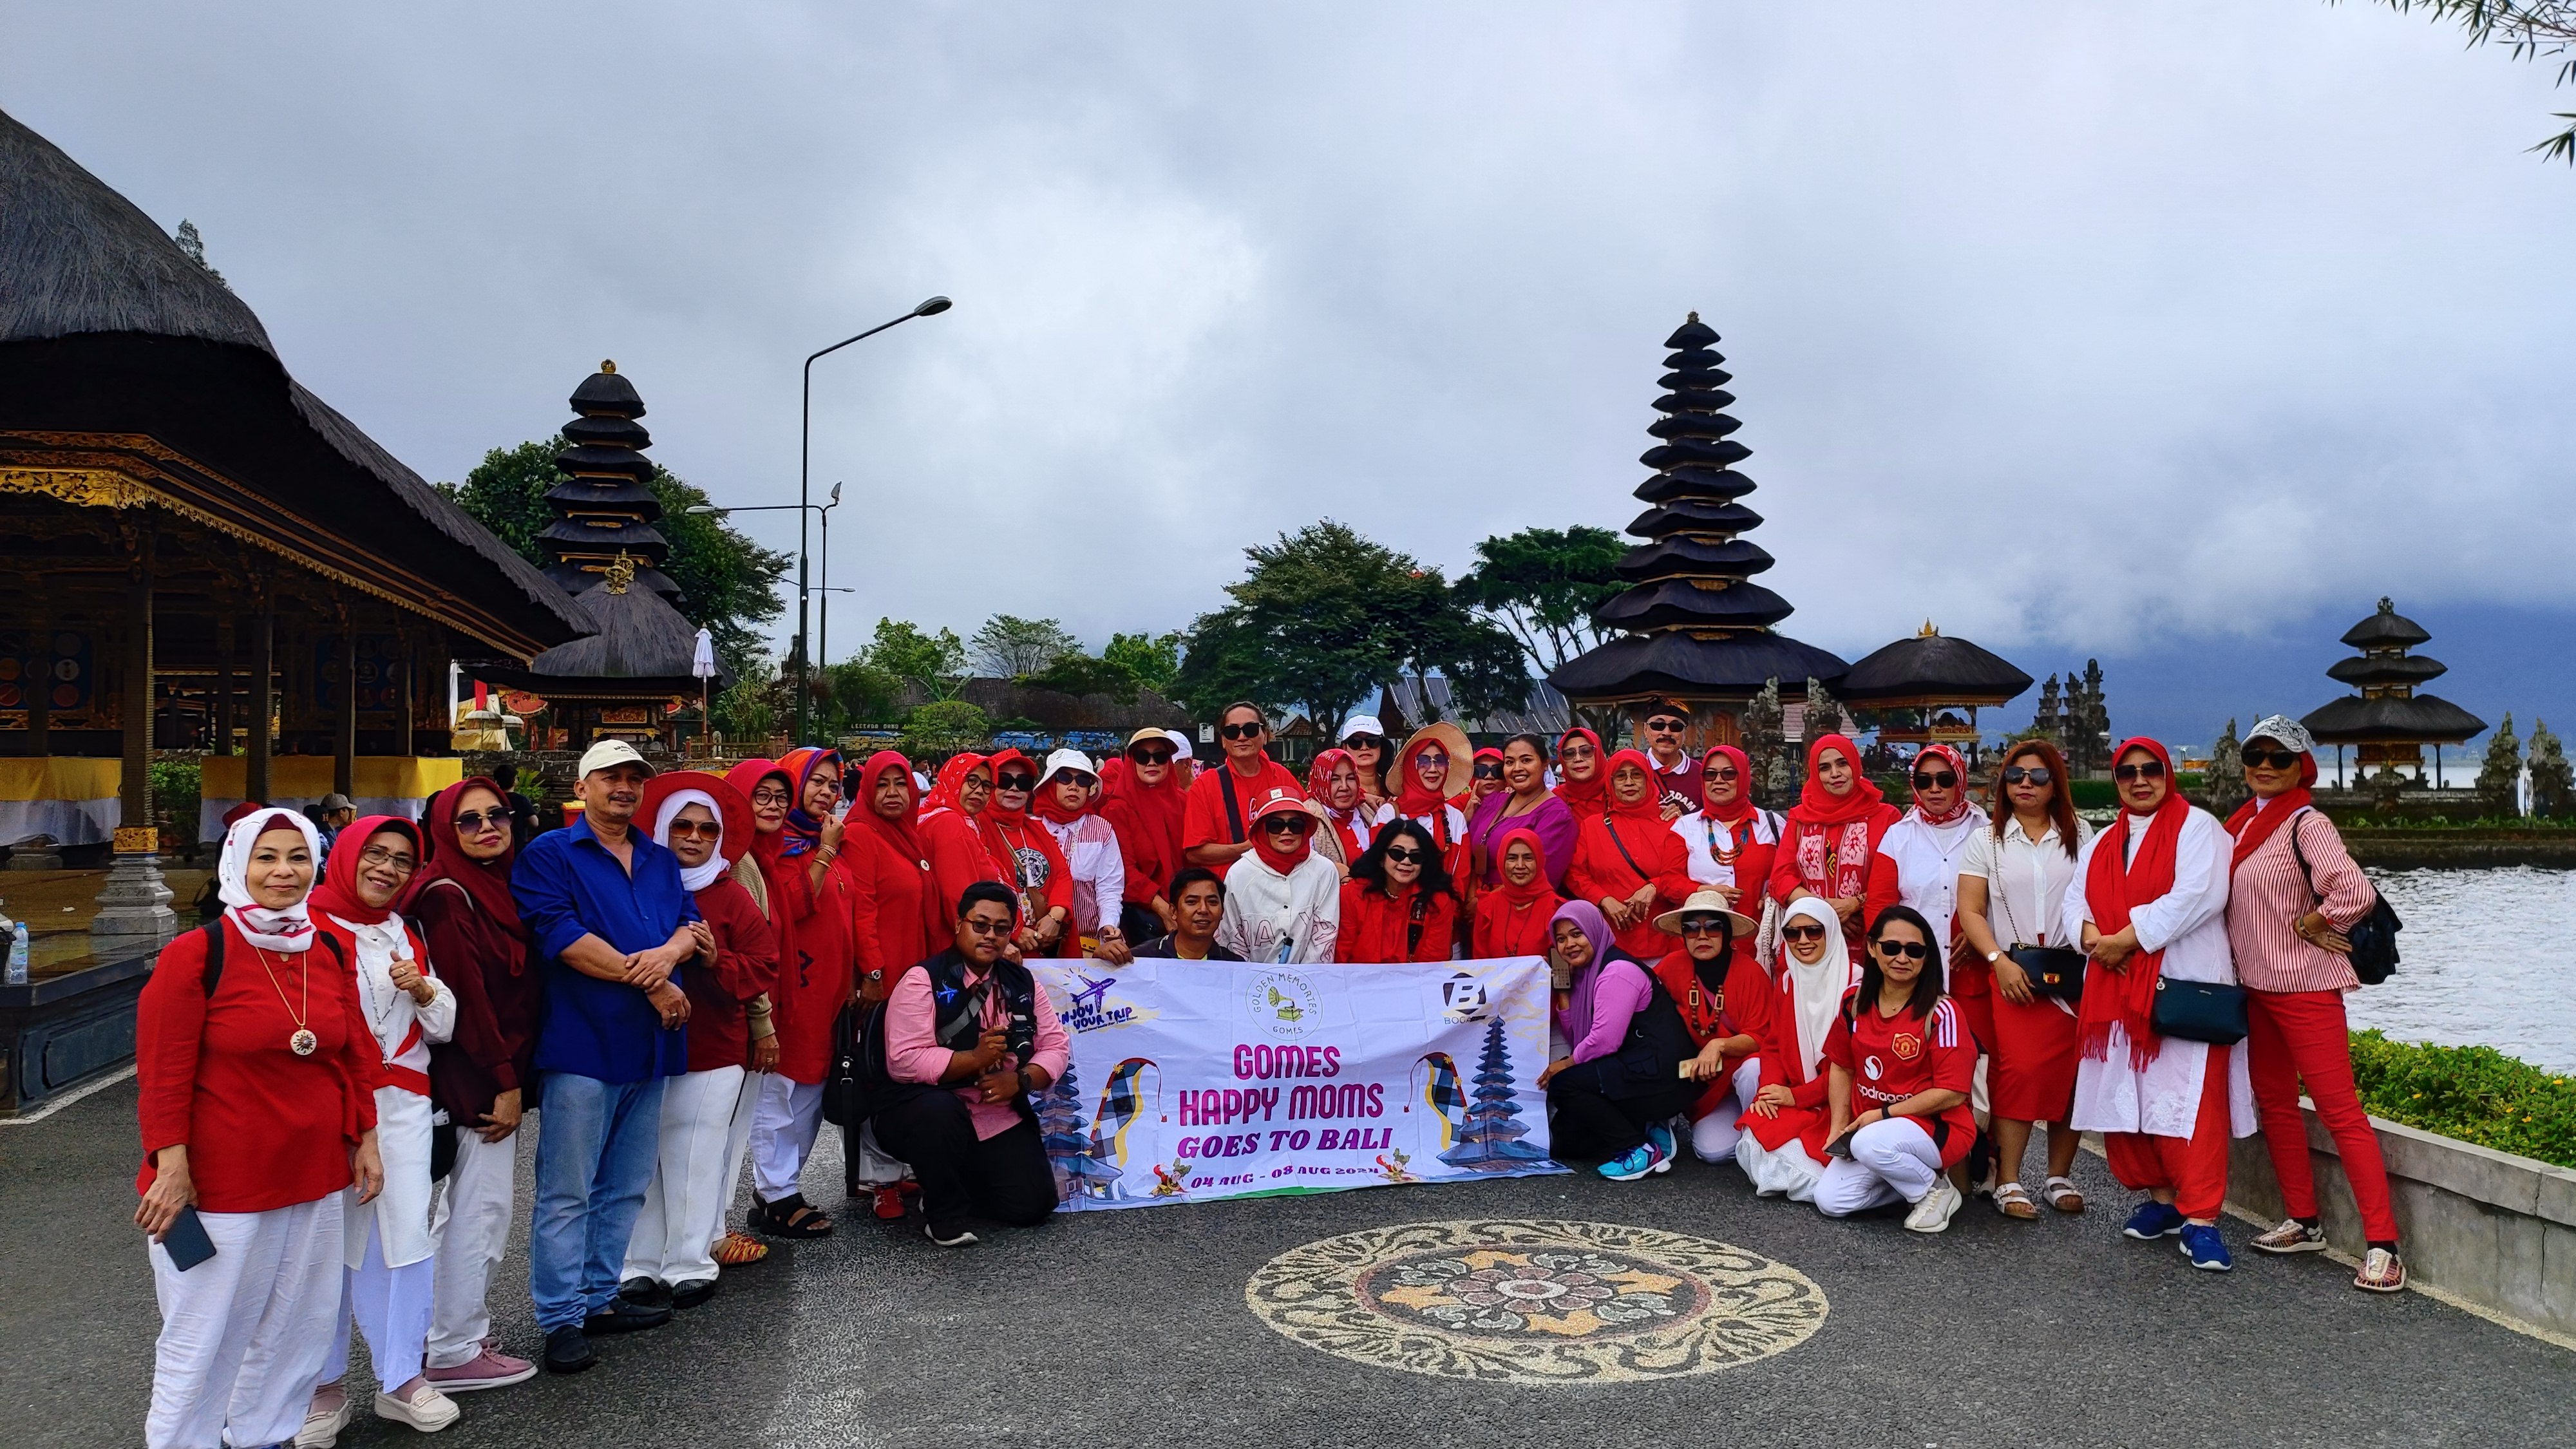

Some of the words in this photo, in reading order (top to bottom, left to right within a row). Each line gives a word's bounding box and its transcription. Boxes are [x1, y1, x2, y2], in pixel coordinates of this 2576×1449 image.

[1252, 975, 1274, 1012] GOLDEN
[1278, 973, 1317, 1015] MEMORIES
[1073, 1014, 1104, 1030] YOUR
[1106, 1007, 1133, 1021] TRIP
[1273, 1026, 1303, 1035] GOMES
[1233, 1044, 1341, 1080] GOMES
[1179, 1086, 1280, 1126] HAPPY
[1288, 1083, 1384, 1121] MOMS
[1857, 1083, 1914, 1103] apdragon
[1177, 1132, 1260, 1159] GOES
[1269, 1129, 1311, 1151] TO
[1316, 1128, 1393, 1150] BALI
[1191, 1177, 1214, 1188] 04
[1218, 1173, 1254, 1186] AUG
[1271, 1165, 1293, 1178] 08
[1296, 1166, 1331, 1175] AUG
